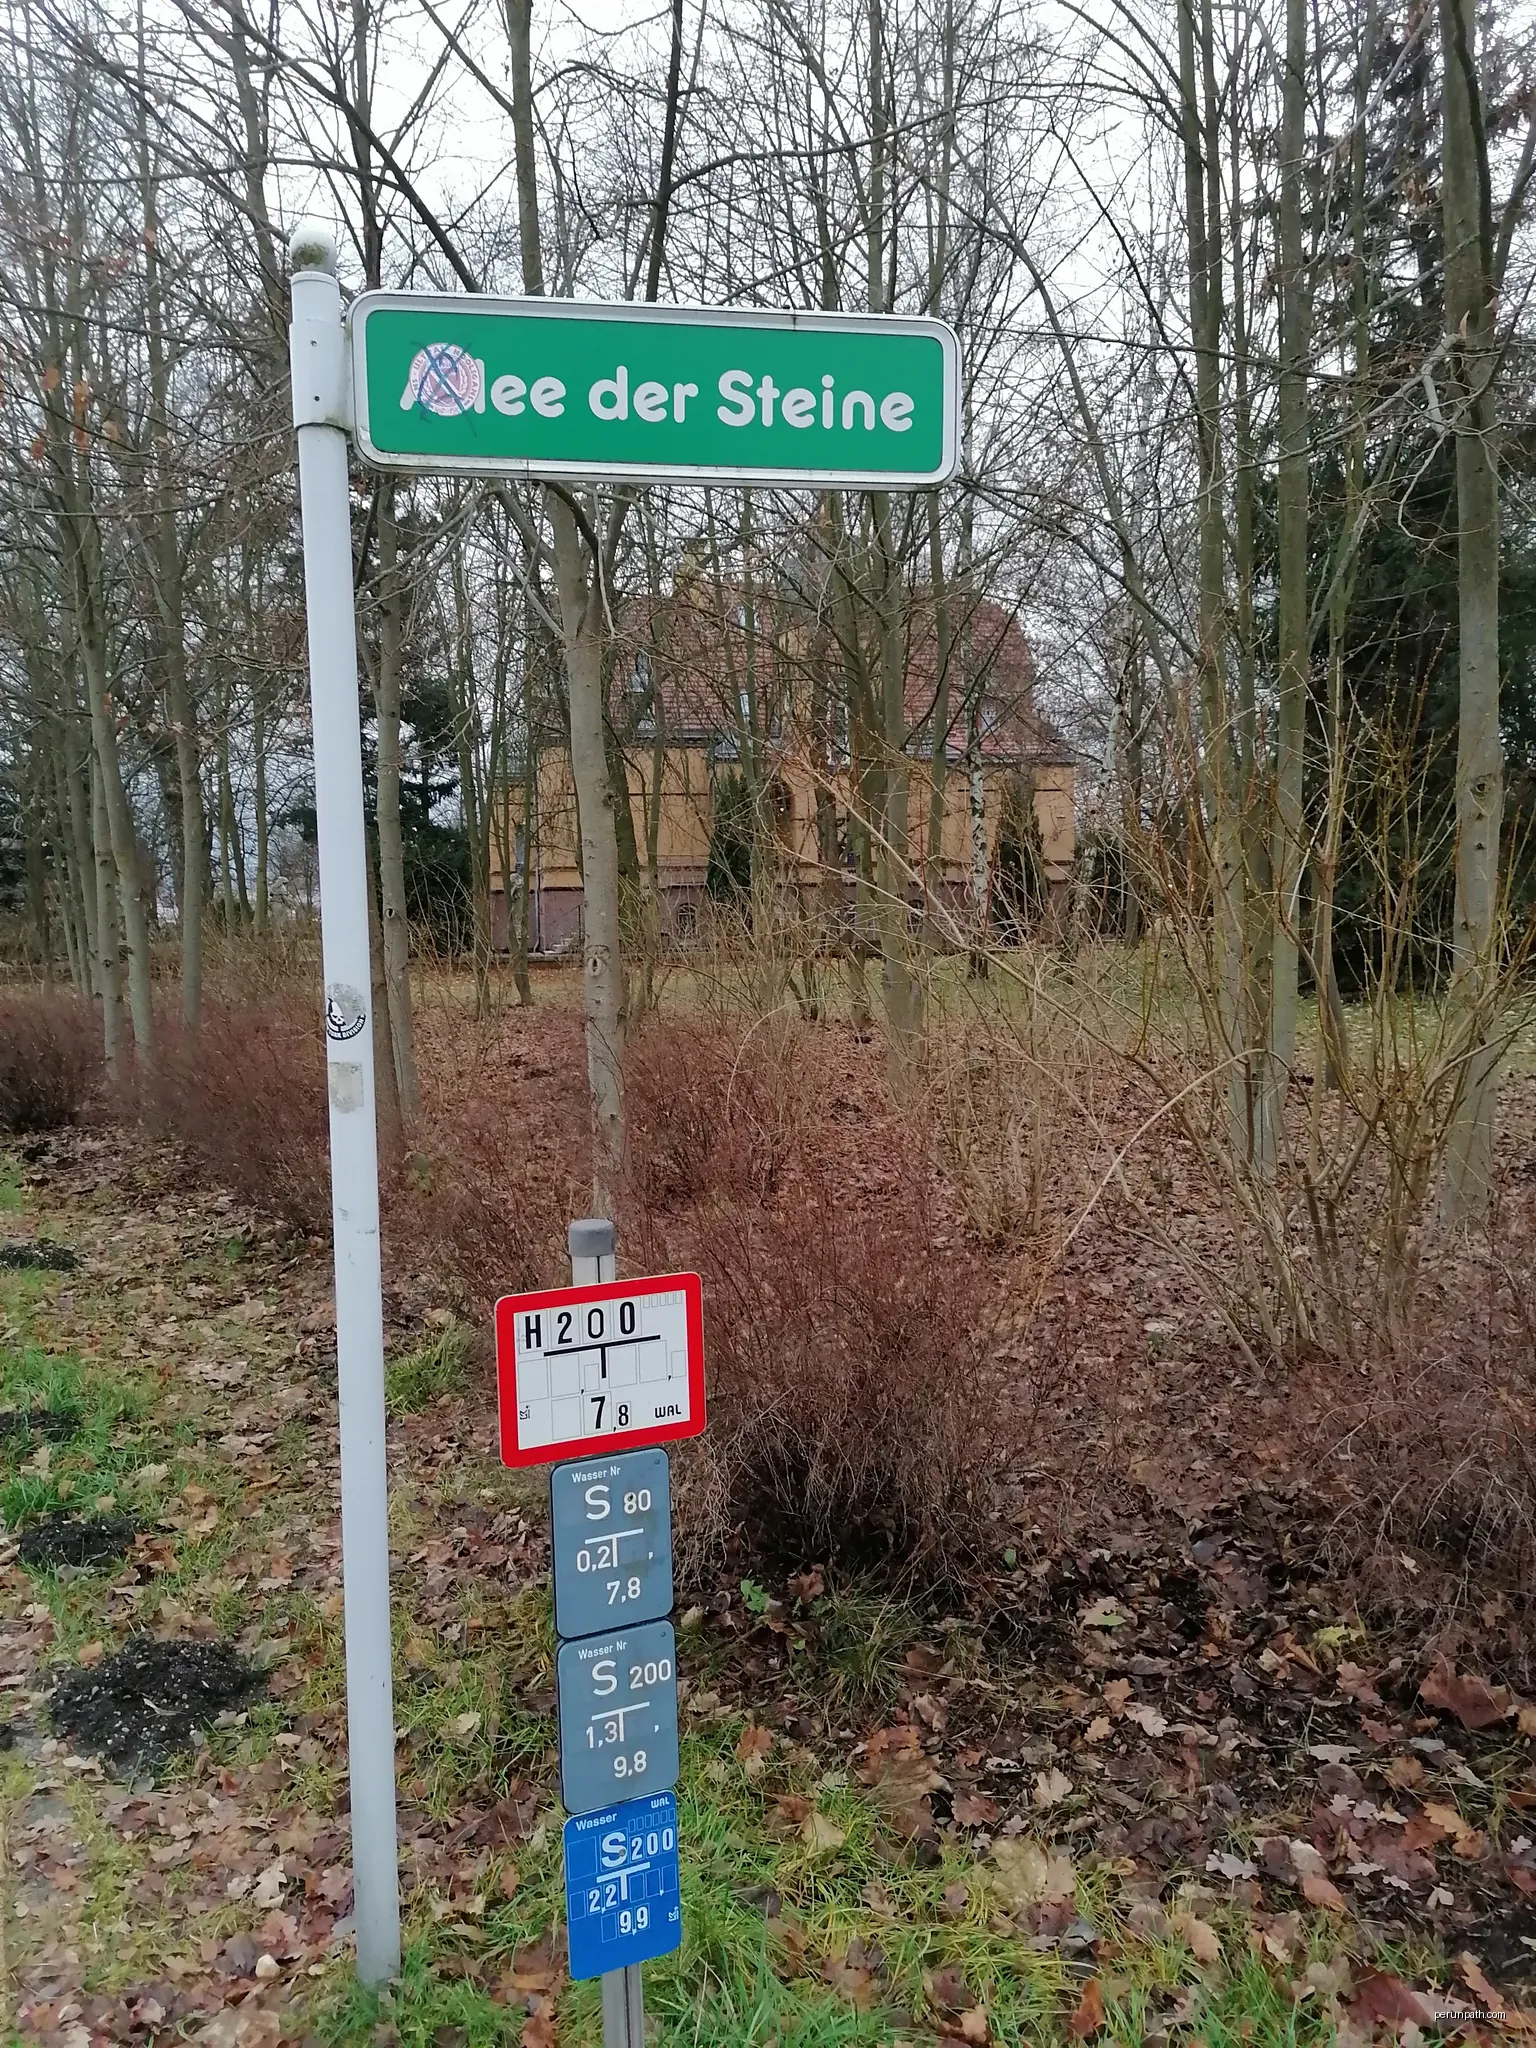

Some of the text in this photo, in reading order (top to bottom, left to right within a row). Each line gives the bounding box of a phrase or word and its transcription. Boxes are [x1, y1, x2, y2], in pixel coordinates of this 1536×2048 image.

[588, 365, 698, 424] der
[717, 369, 915, 432] Steine
[654, 1403, 682, 1419] WAL
[571, 1465, 621, 1483] Wasser Nr
[584, 1485, 651, 1520] S 80
[606, 1576, 641, 1606] 7,8
[578, 1640, 627, 1660] Wasser Nr
[591, 1659, 671, 1696] S 200
[613, 1750, 647, 1778] 9,8
[650, 1797, 670, 1809] WAL
[575, 1813, 618, 1832] Wasser
